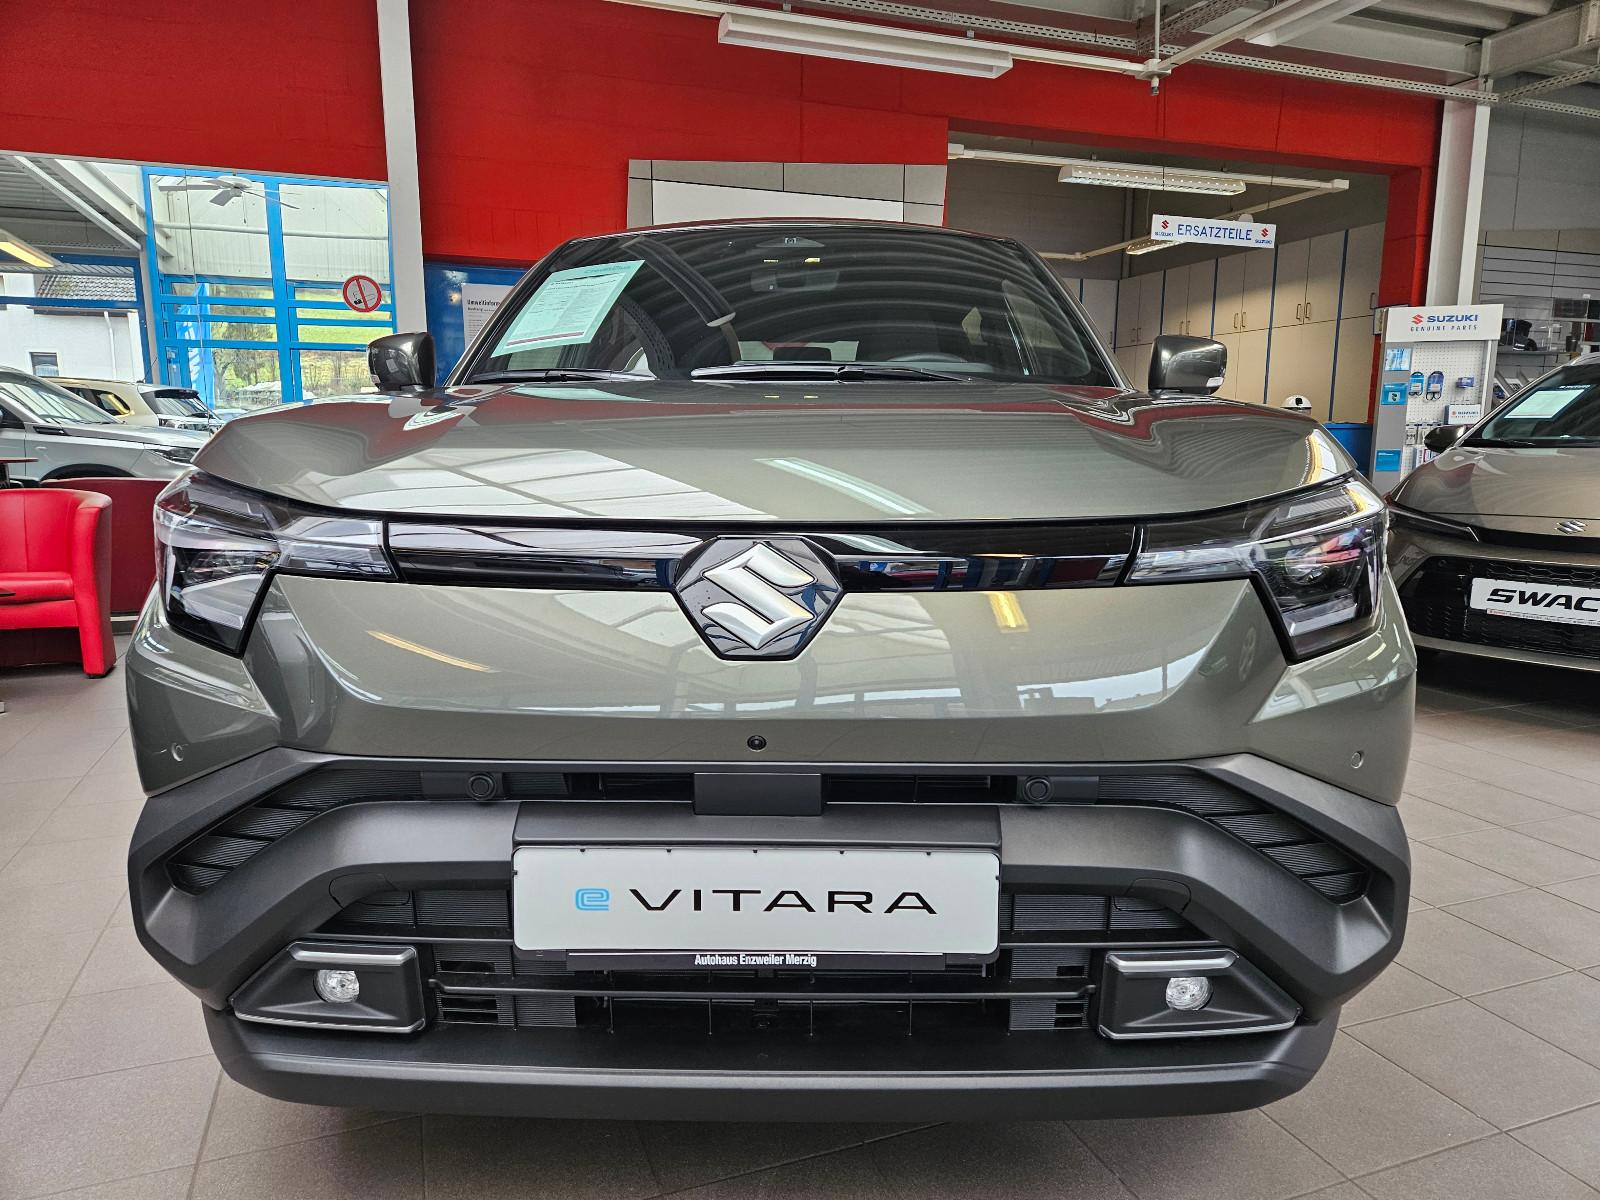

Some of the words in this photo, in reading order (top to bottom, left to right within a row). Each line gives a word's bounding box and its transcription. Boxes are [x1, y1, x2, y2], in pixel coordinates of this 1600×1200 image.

[1177, 224, 1253, 241] ERSATZTEILE
[1426, 314, 1479, 323] SUZUKI
[1486, 588, 1600, 613] SWAC
[628, 888, 938, 915] VITARA
[694, 954, 738, 965] Autohaus
[740, 954, 785, 965] Enzweiler
[786, 954, 817, 968] Merzig
